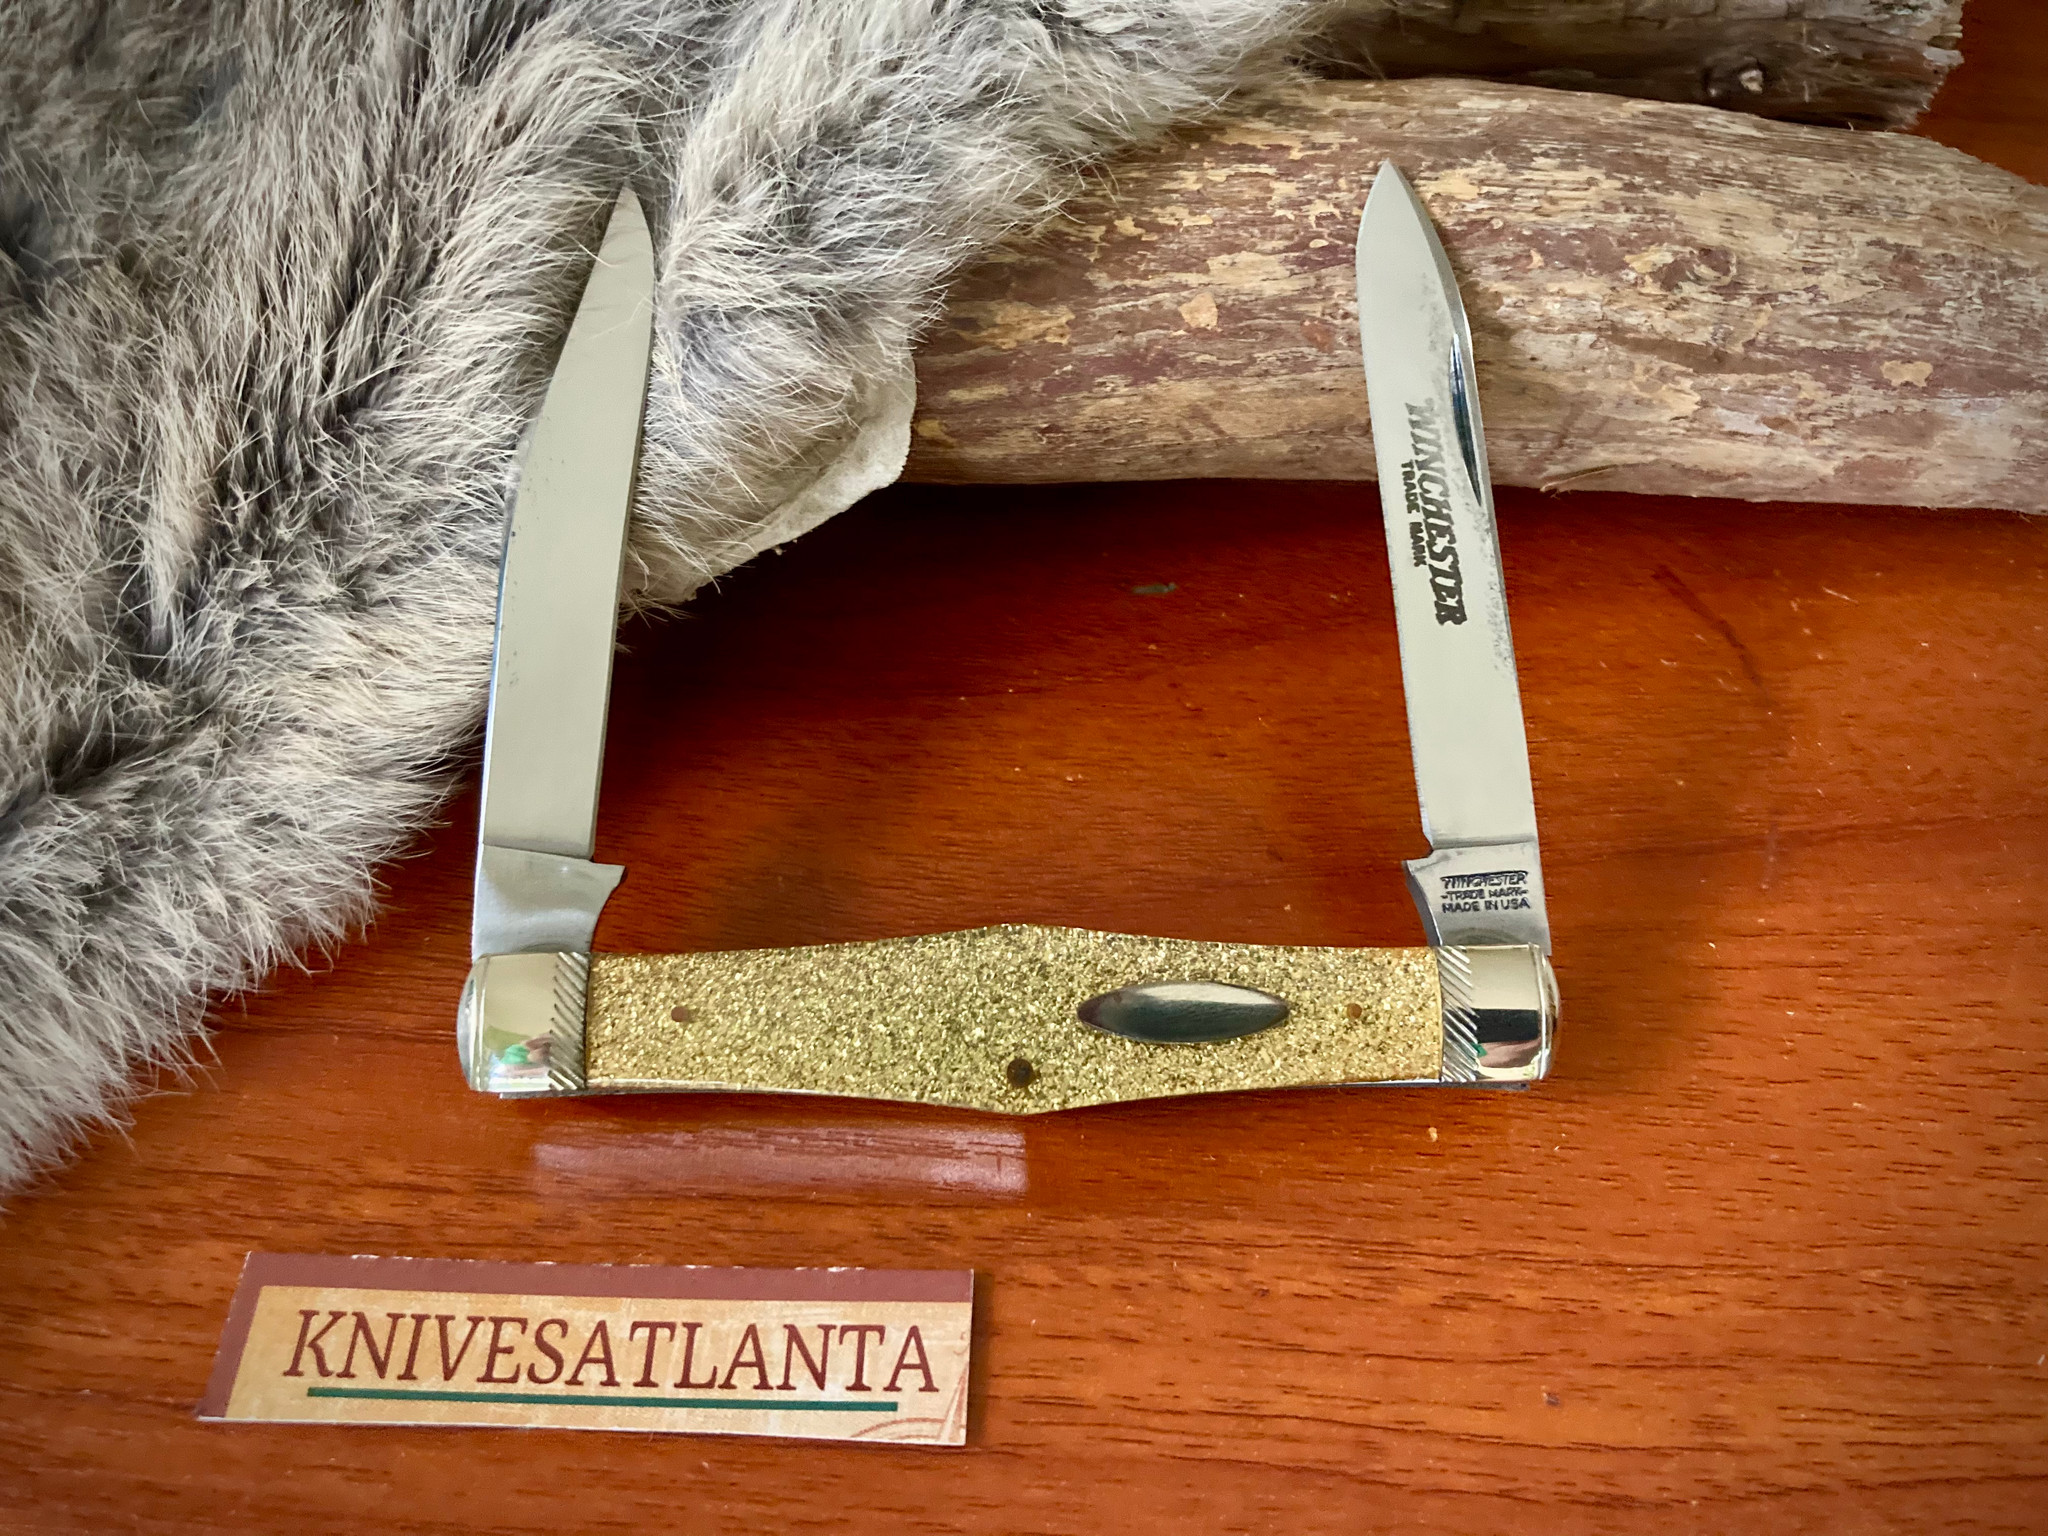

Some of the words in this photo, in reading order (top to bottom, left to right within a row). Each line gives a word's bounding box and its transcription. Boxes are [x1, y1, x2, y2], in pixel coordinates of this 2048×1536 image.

[1401, 458, 1421, 514] TRADE
[1404, 398, 1468, 626] WINCHESTER
[1409, 521, 1427, 567] MARK
[1442, 901, 1480, 913] MADE
[1485, 899, 1498, 911] IN
[1500, 897, 1531, 910] USA
[282, 1309, 941, 1394] KNIVESATLANTA
